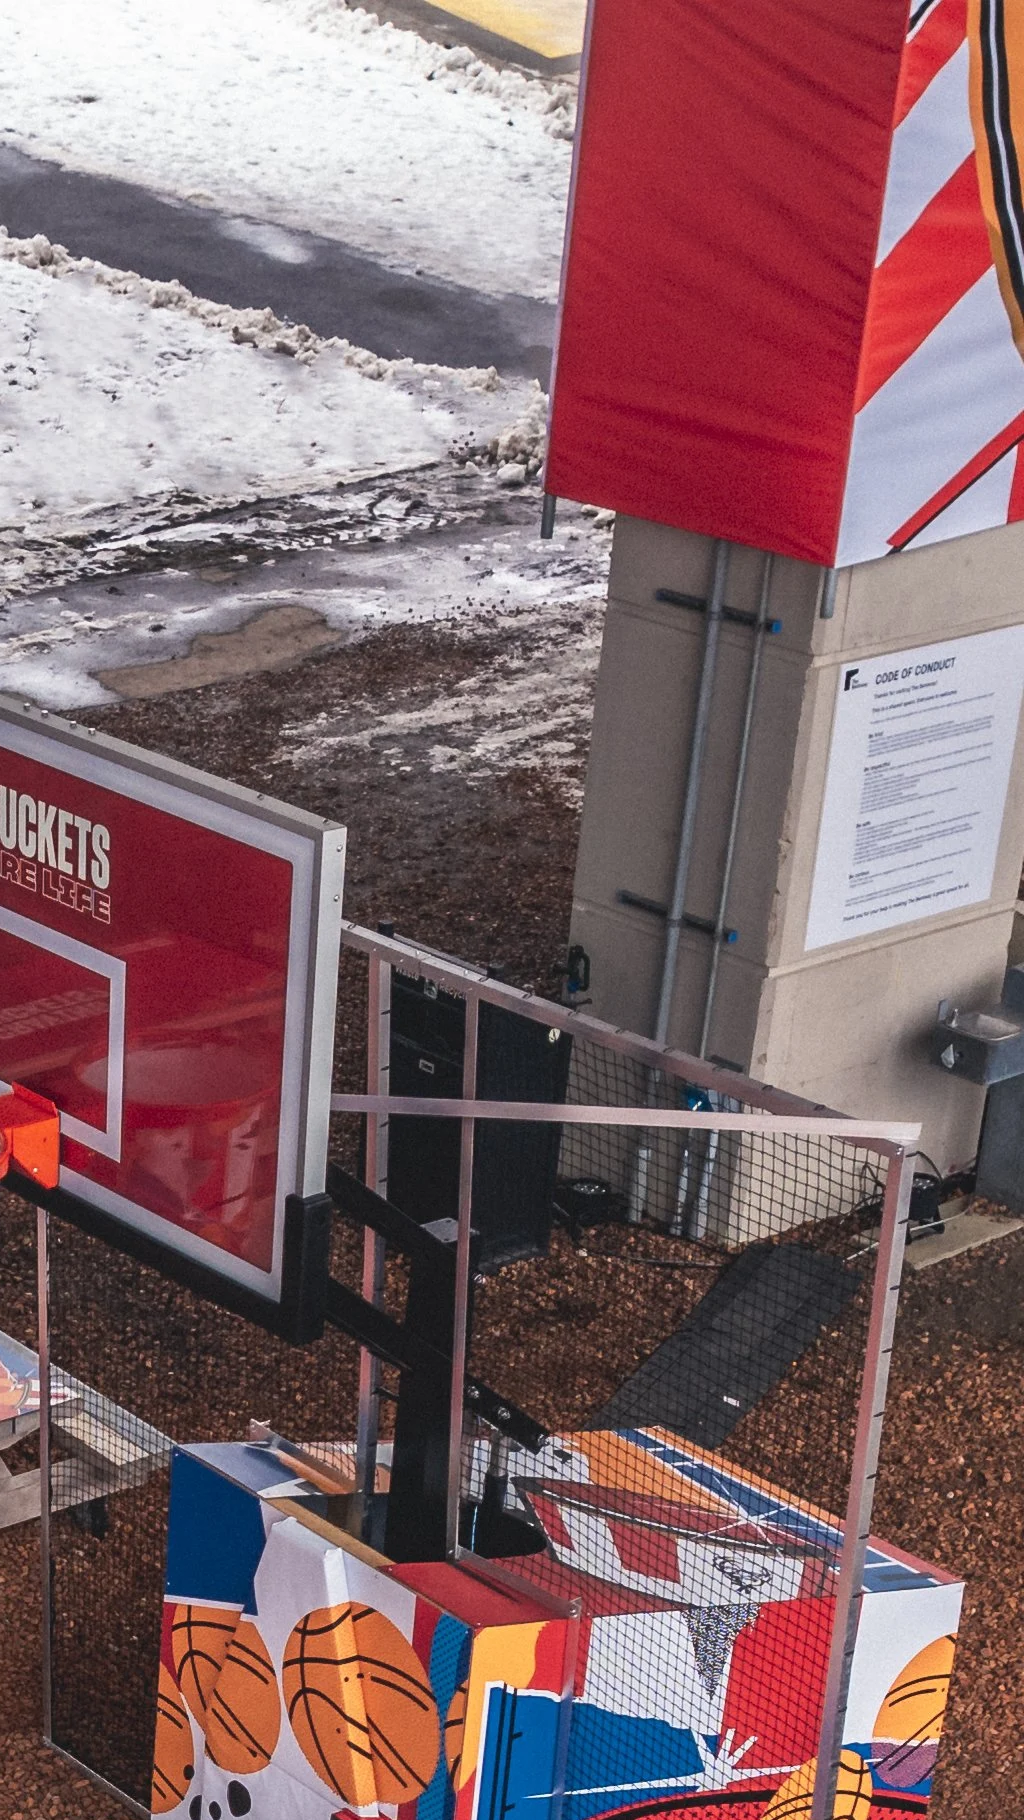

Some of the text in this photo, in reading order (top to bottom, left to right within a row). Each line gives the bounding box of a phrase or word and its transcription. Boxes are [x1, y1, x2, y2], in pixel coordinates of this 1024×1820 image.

[875, 669, 899, 685] CODE
[901, 666, 914, 679] OF
[915, 657, 957, 676] CONDUCT
[42, 868, 111, 925] LIFE
